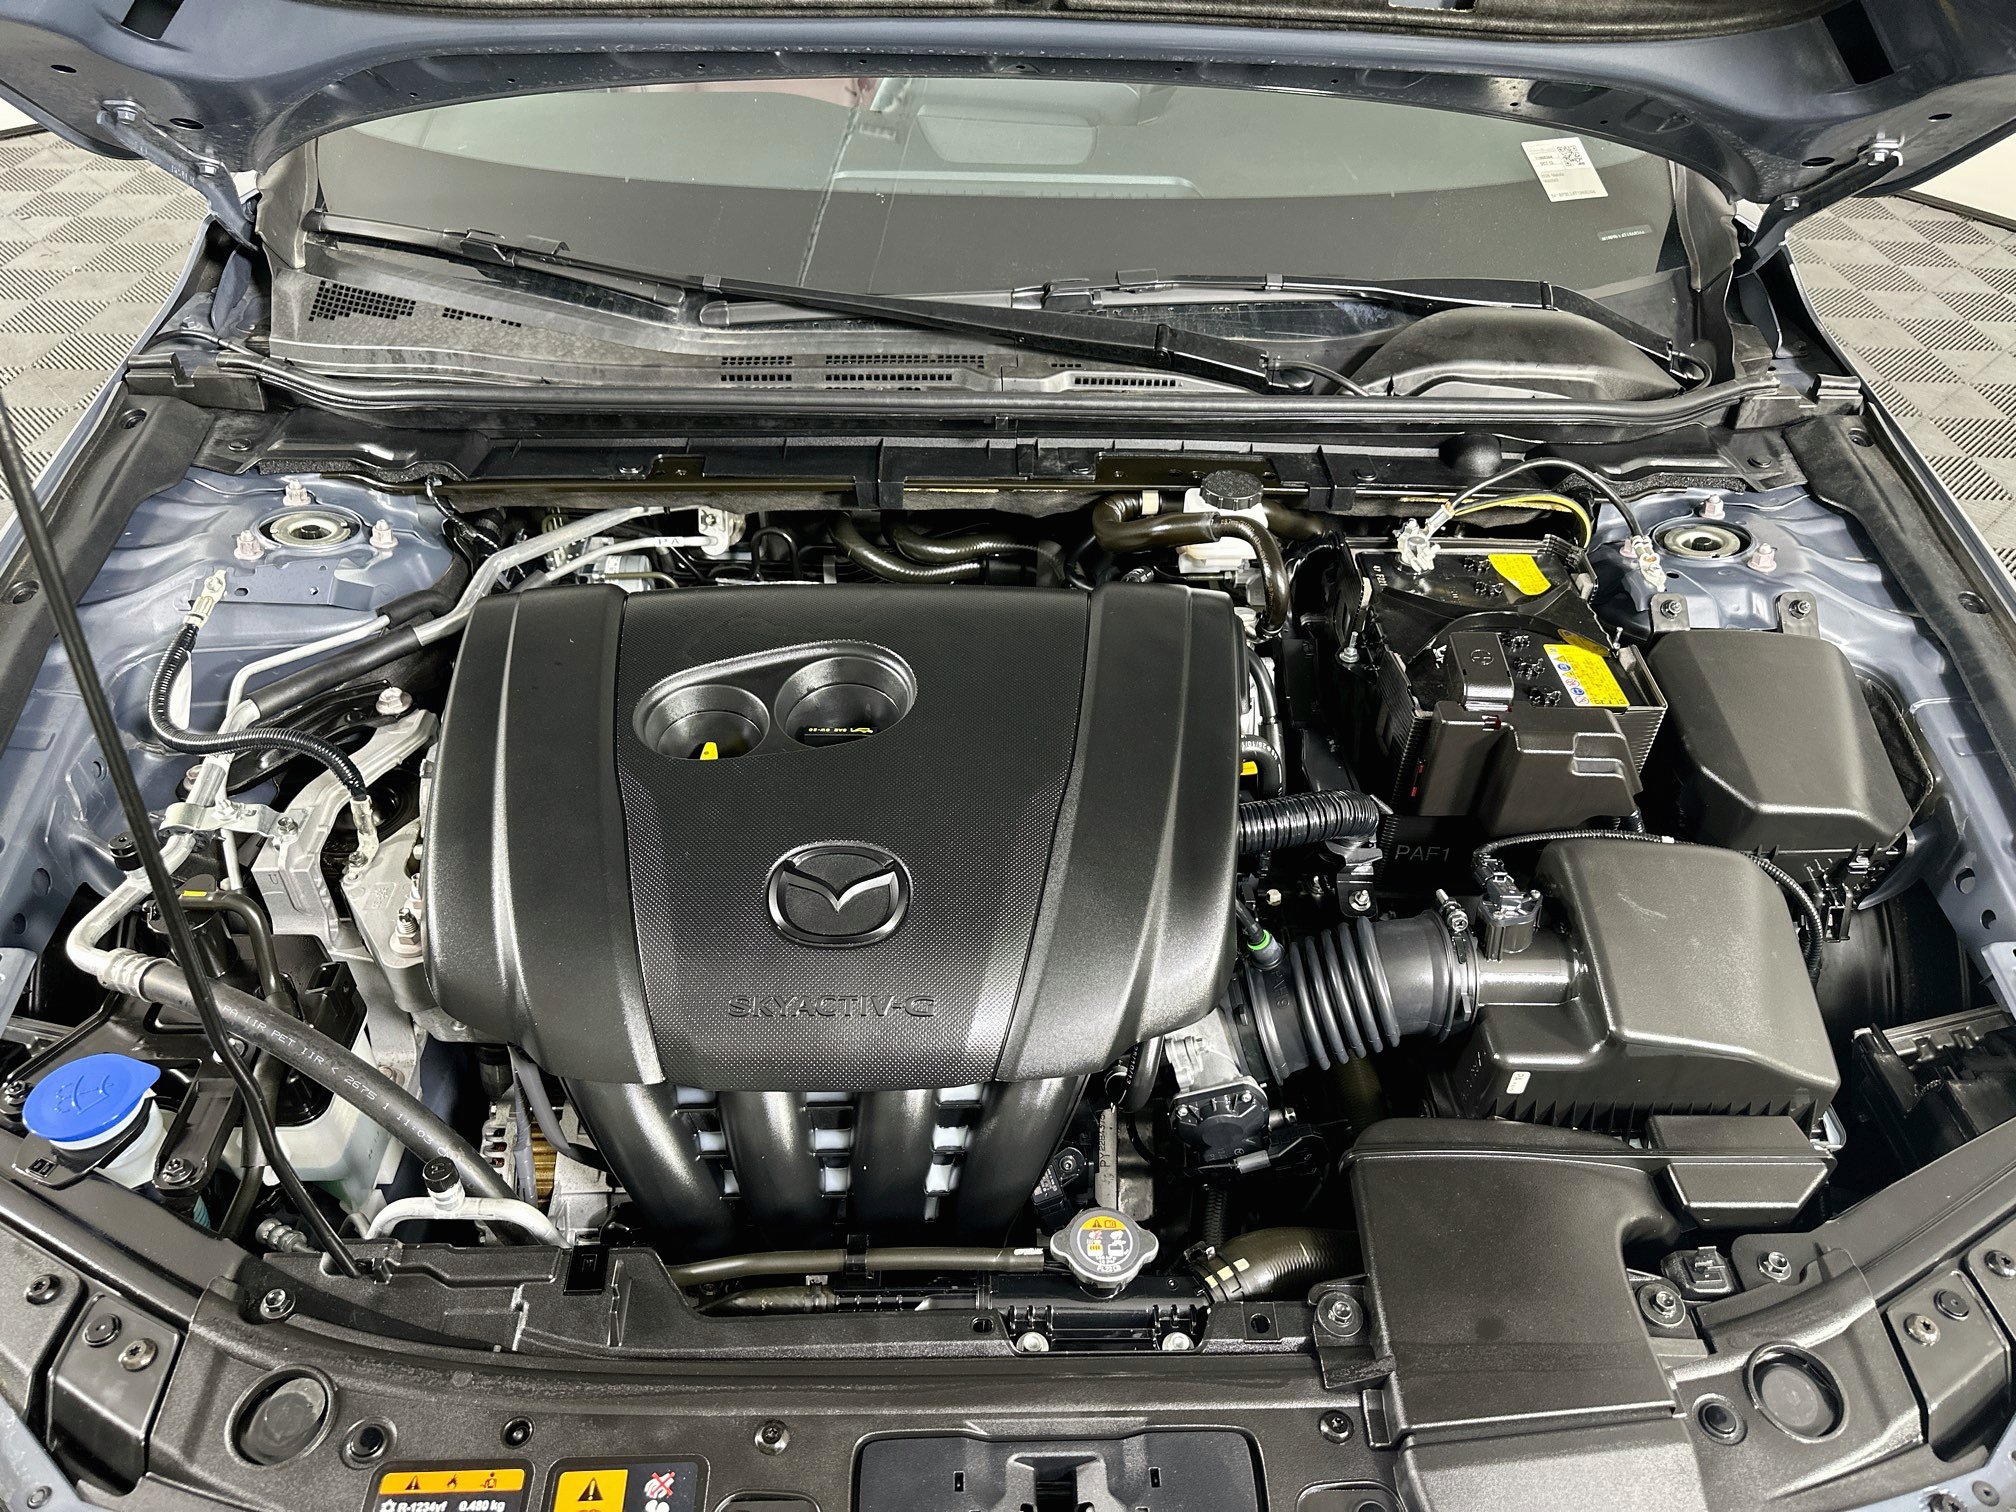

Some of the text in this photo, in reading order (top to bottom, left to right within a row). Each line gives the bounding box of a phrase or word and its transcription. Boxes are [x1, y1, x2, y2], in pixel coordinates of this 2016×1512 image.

[1394, 844, 1450, 862] PAF1
[728, 995, 936, 1017] SKYACTIV-G
[222, 1005, 239, 1018] PA
[244, 1015, 267, 1032] IIR
[270, 1029, 296, 1047] PET
[300, 1046, 326, 1065] IIR
[343, 1075, 378, 1101] 2675
[396, 1112, 434, 1144] 11:03
[490, 1499, 506, 1512] kg
